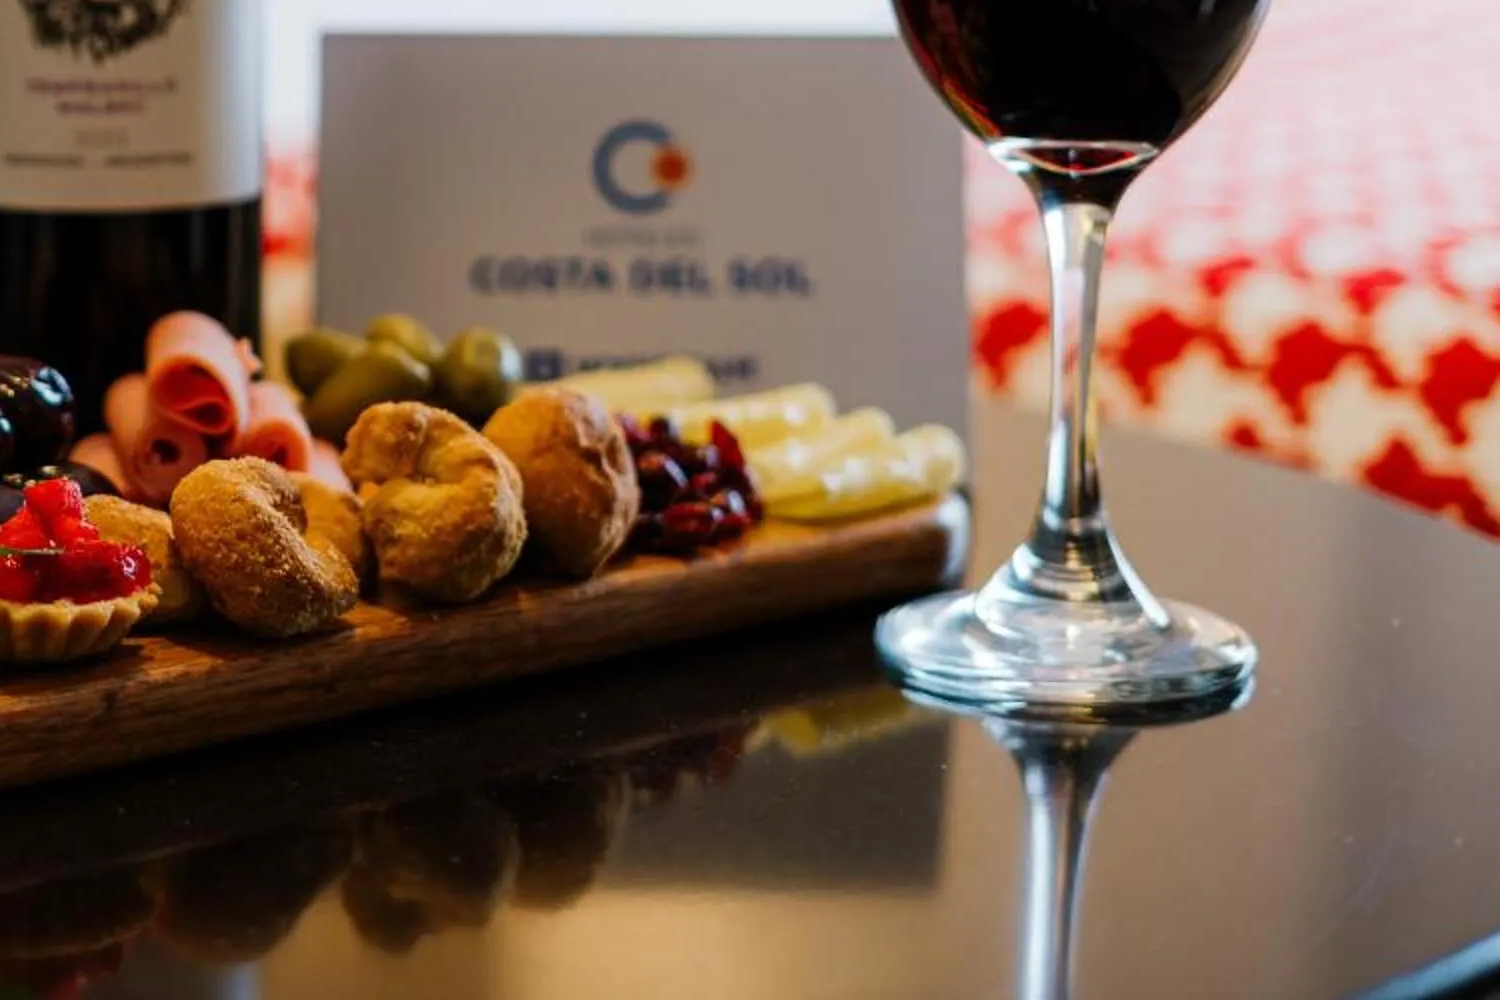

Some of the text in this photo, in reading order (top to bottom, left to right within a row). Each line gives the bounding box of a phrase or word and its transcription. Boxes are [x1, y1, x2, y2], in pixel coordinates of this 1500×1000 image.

[469, 256, 813, 297] COSTA DEL SOL
